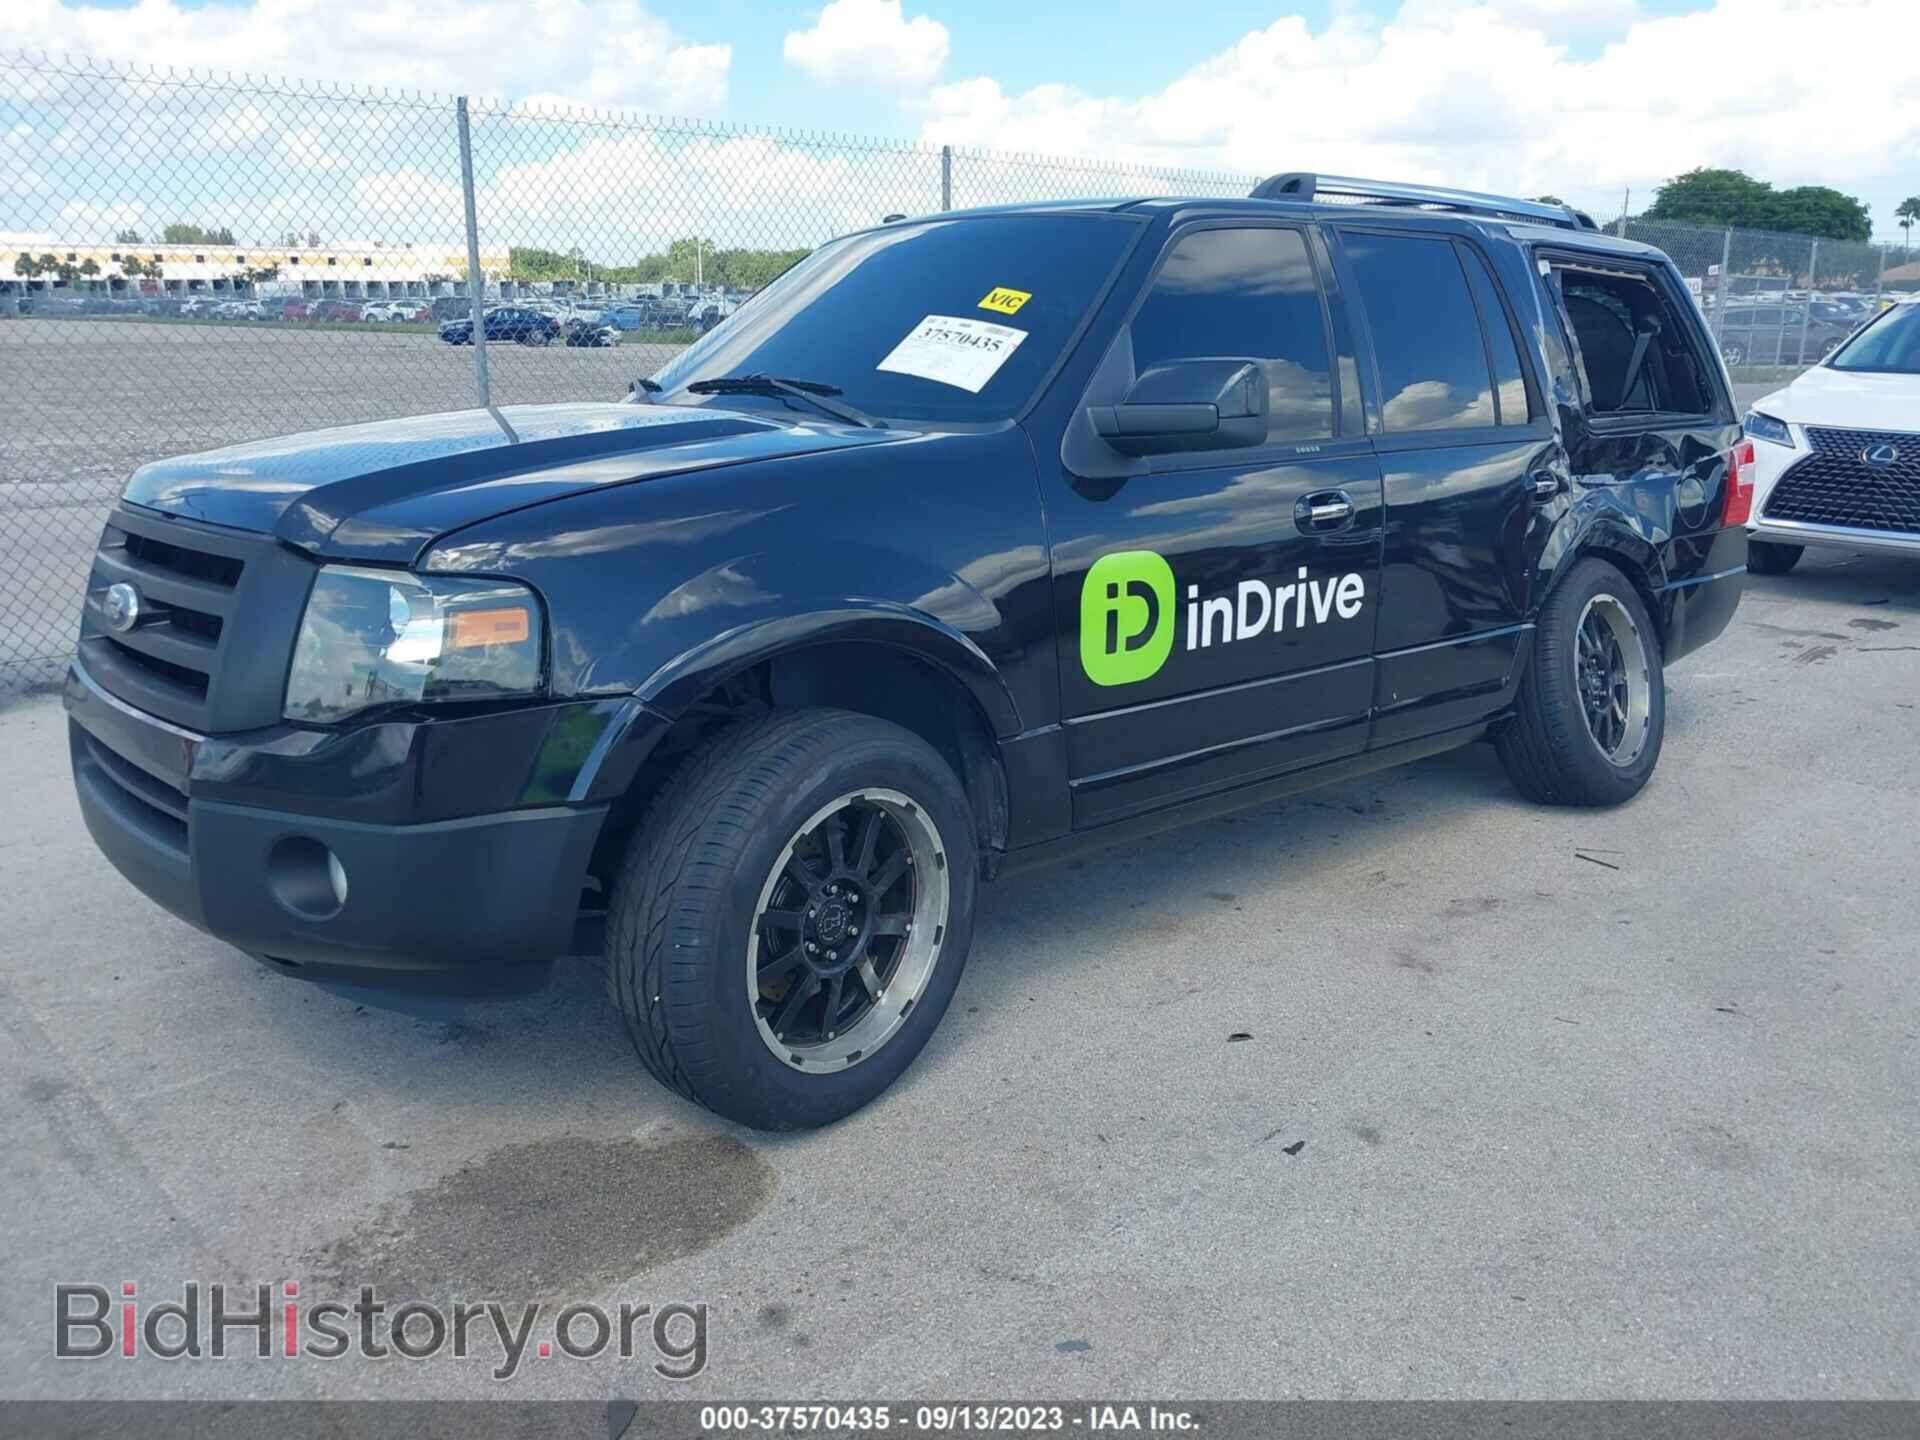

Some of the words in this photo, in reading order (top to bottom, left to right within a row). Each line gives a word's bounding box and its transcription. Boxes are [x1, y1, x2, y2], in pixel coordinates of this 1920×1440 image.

[990, 292, 1023, 308] VIC
[919, 327, 1003, 352] 37570435
[1186, 566, 1365, 651] inDrive
